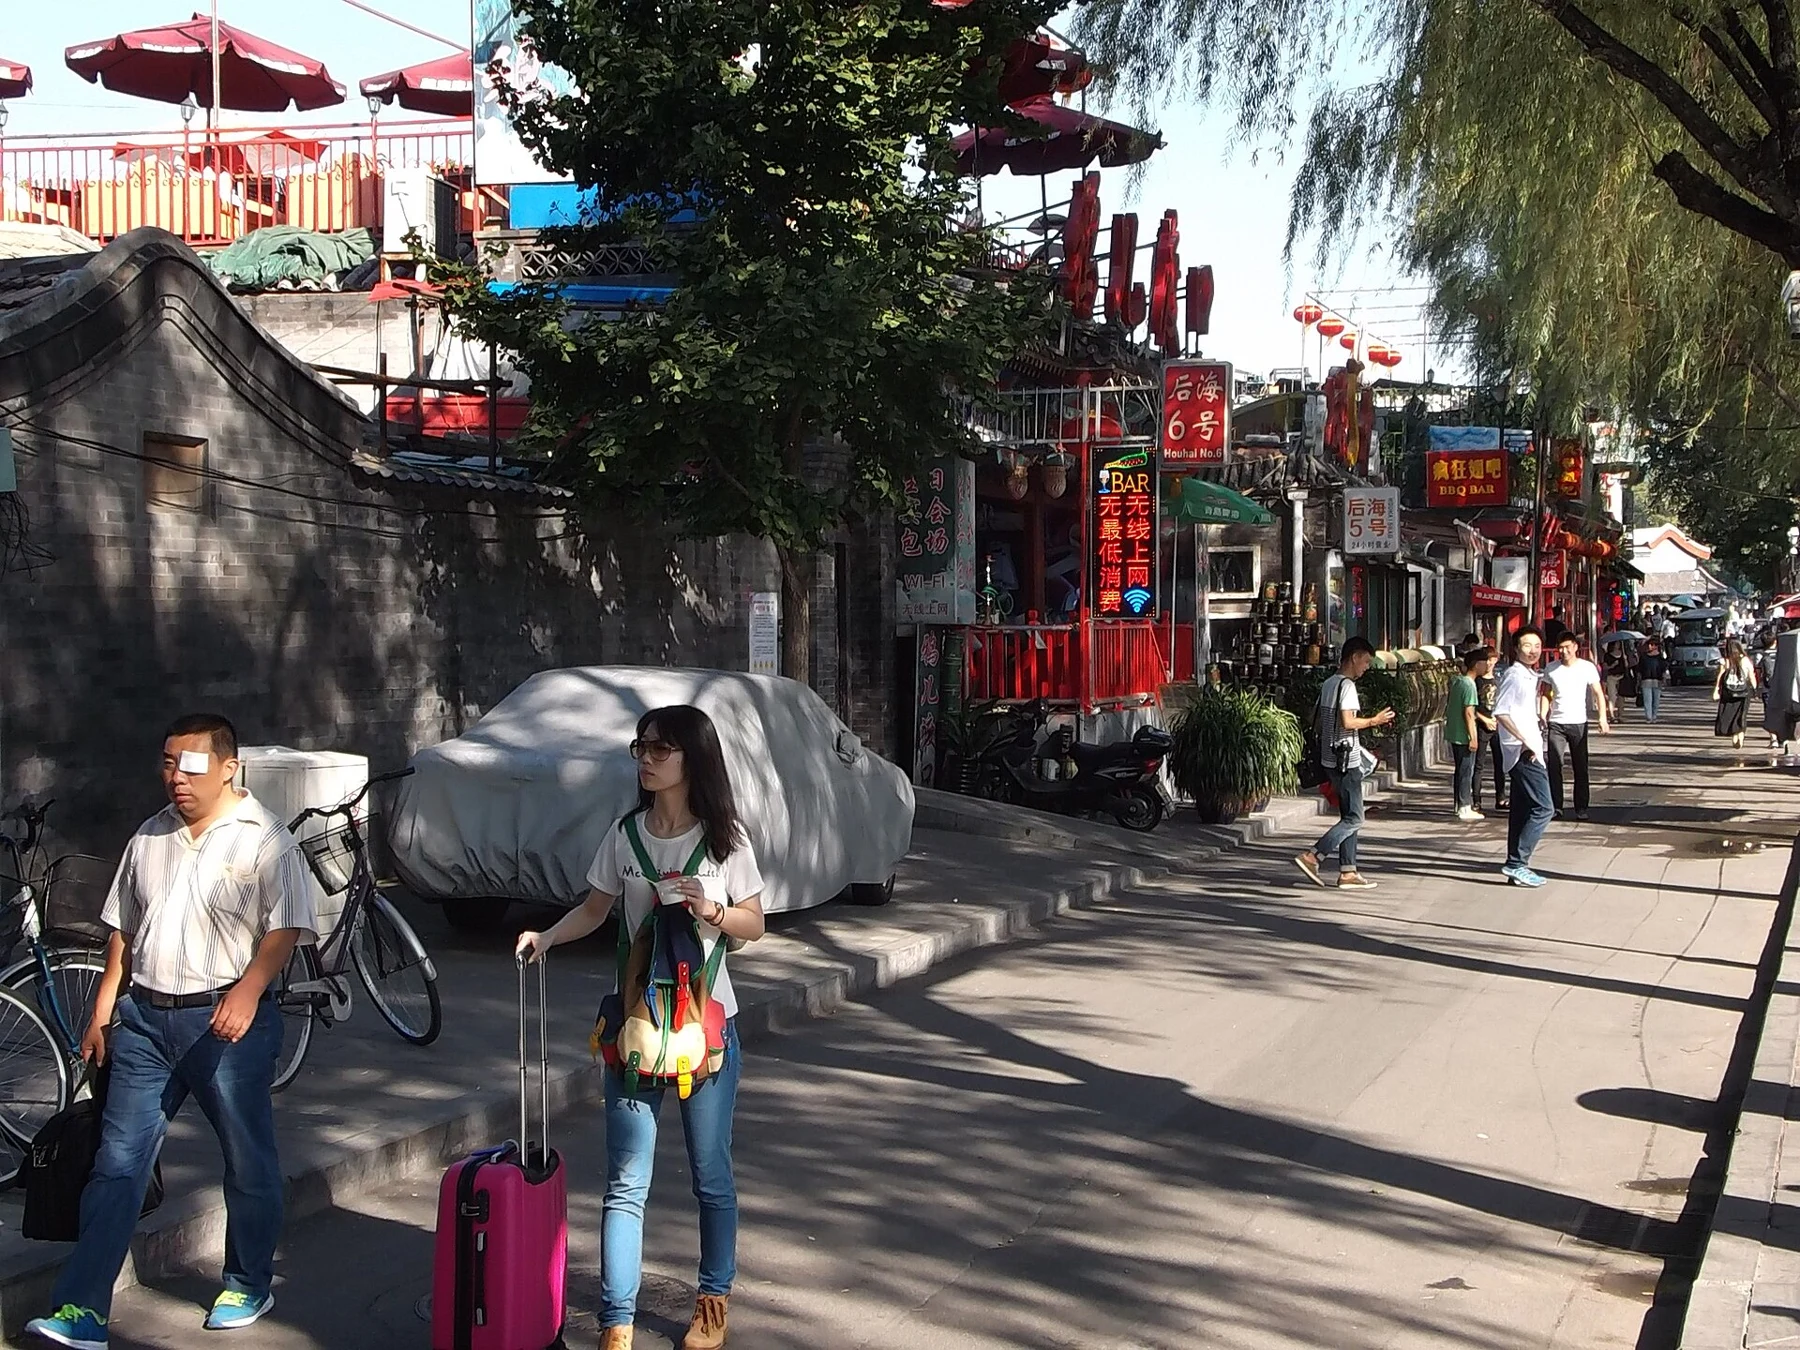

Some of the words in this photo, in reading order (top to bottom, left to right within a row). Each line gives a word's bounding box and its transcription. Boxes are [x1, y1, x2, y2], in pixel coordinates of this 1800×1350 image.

[1168, 371, 1223, 403] 后海
[1168, 410, 1220, 441] 6号
[1164, 448, 1198, 459] Houhai
[1200, 448, 1222, 458] No.6
[1111, 472, 1150, 493] BAR
[1440, 486, 1466, 496] BBQ
[1469, 485, 1494, 494] BAR
[1348, 498, 1386, 517] 后海
[1350, 519, 1387, 537] 5号
[1126, 495, 1150, 588] 无线上网
[1099, 496, 1122, 612] 无最低消费
[903, 603, 948, 615] 无线上网
